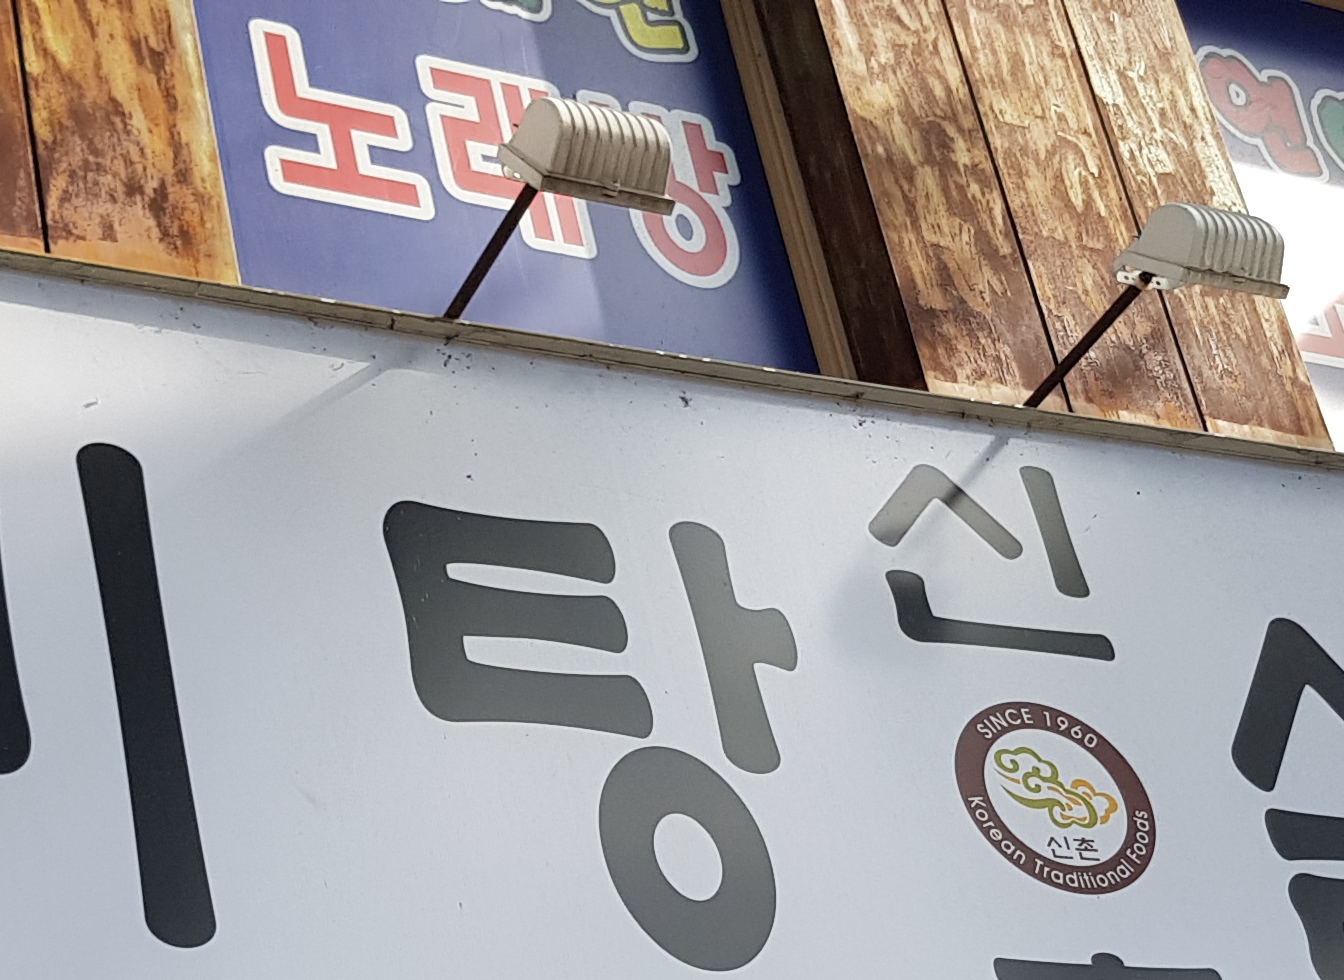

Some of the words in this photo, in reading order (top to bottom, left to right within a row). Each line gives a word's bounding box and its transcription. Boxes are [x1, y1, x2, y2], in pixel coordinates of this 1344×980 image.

[248, 19, 741, 289] 노래방
[976, 708, 1035, 740] SINCE
[1043, 711, 1098, 749] 1960
[968, 796, 1027, 865] Korean
[1032, 857, 1135, 890] Traditional
[1127, 810, 1150, 865] Foods
[1047, 836, 1100, 861] 신촌
